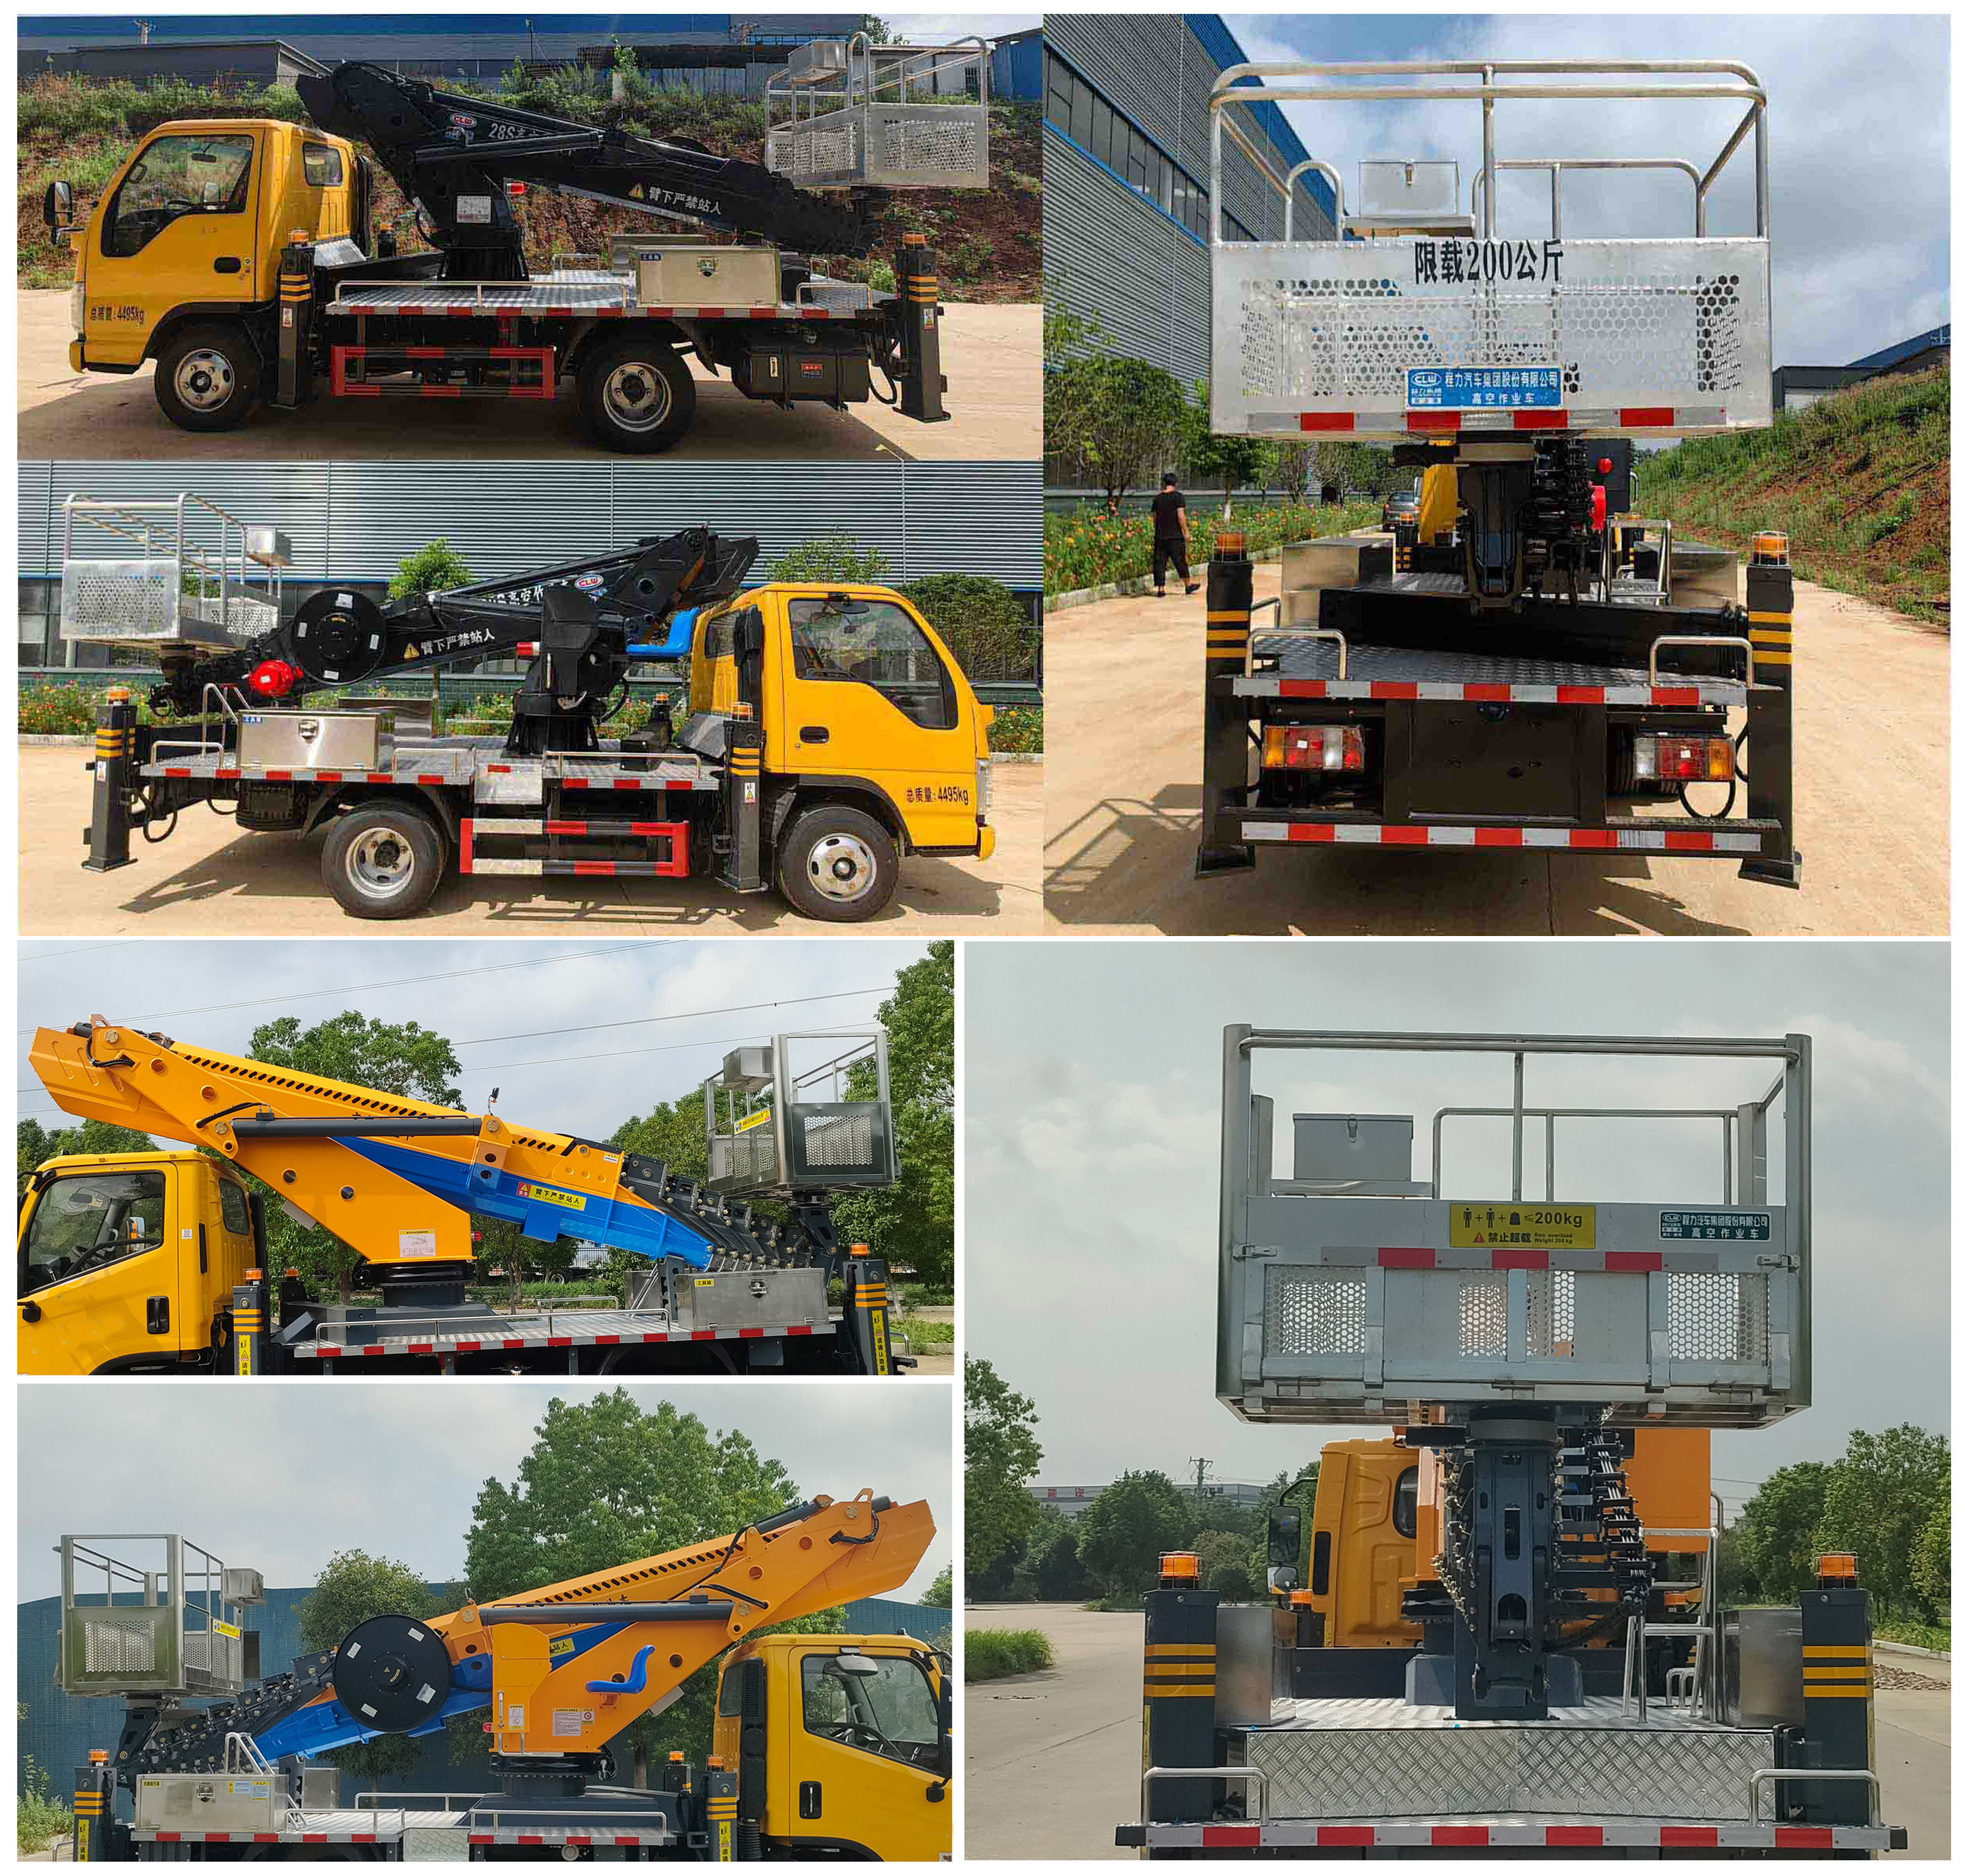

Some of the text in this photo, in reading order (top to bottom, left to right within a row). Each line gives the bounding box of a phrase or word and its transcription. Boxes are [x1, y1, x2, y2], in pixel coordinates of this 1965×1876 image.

[649, 187, 721, 215] 臂下严禁站人
[1414, 236, 1564, 284] 限载200公斤
[1445, 371, 1558, 388] 程力汽车集团股份有限公司
[1472, 392, 1535, 404] 高空作业车
[421, 628, 495, 655] 臂下严禁站人
[535, 1188, 580, 1205] 臂下严禁站人
[1682, 1214, 1768, 1227] 程力汽车集团股份有限公司
[1488, 1232, 1531, 1243] 禁止超载
[1692, 1227, 1759, 1239] 高空作业车
